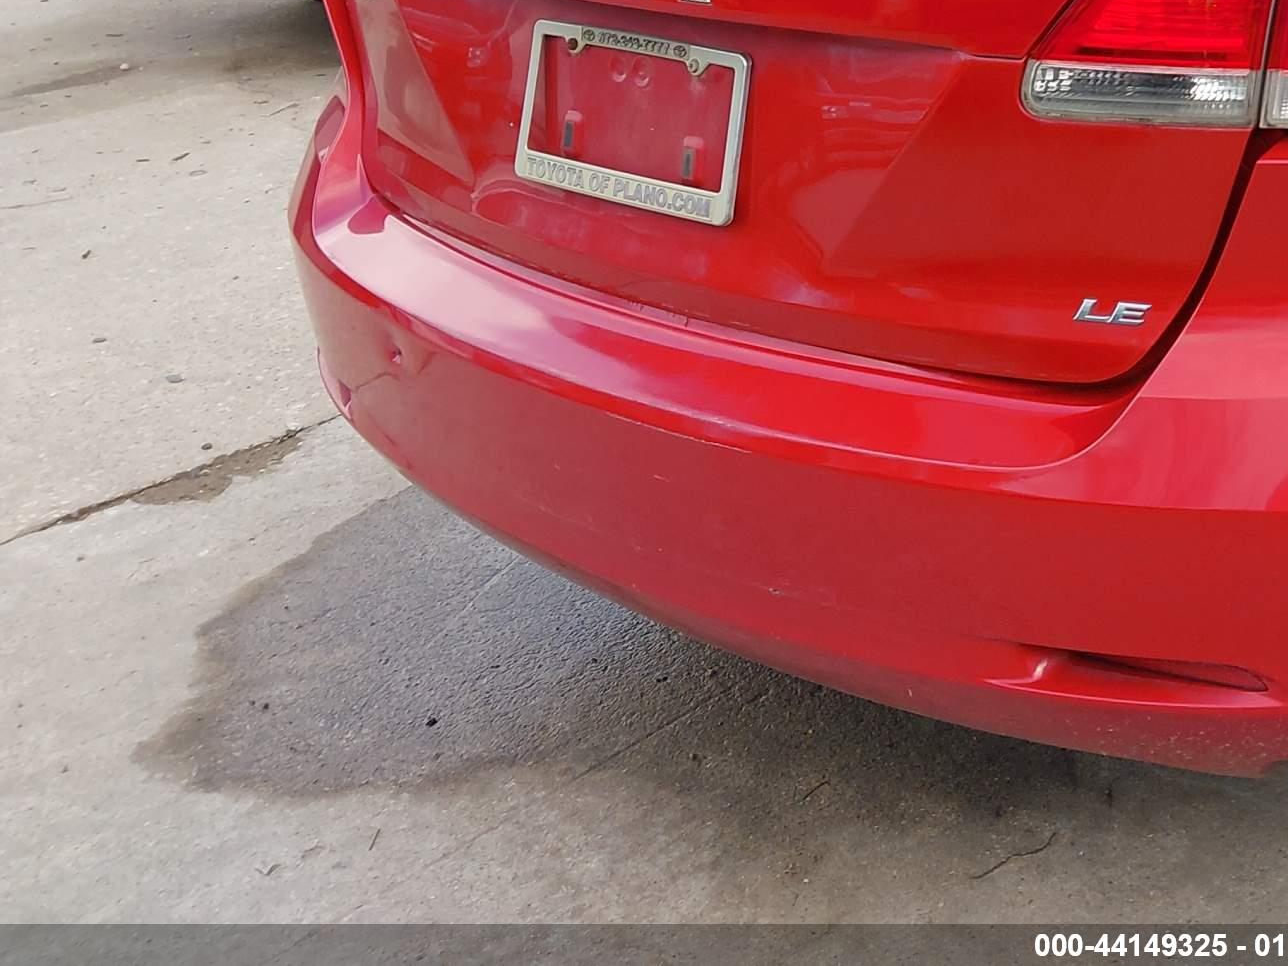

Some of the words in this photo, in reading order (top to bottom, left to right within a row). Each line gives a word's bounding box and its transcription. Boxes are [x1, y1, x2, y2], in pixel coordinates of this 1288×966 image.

[527, 157, 585, 188] TOYOTA
[589, 172, 611, 194] OF
[612, 177, 712, 219] PLANO.COM
[1072, 298, 1153, 326] LE
